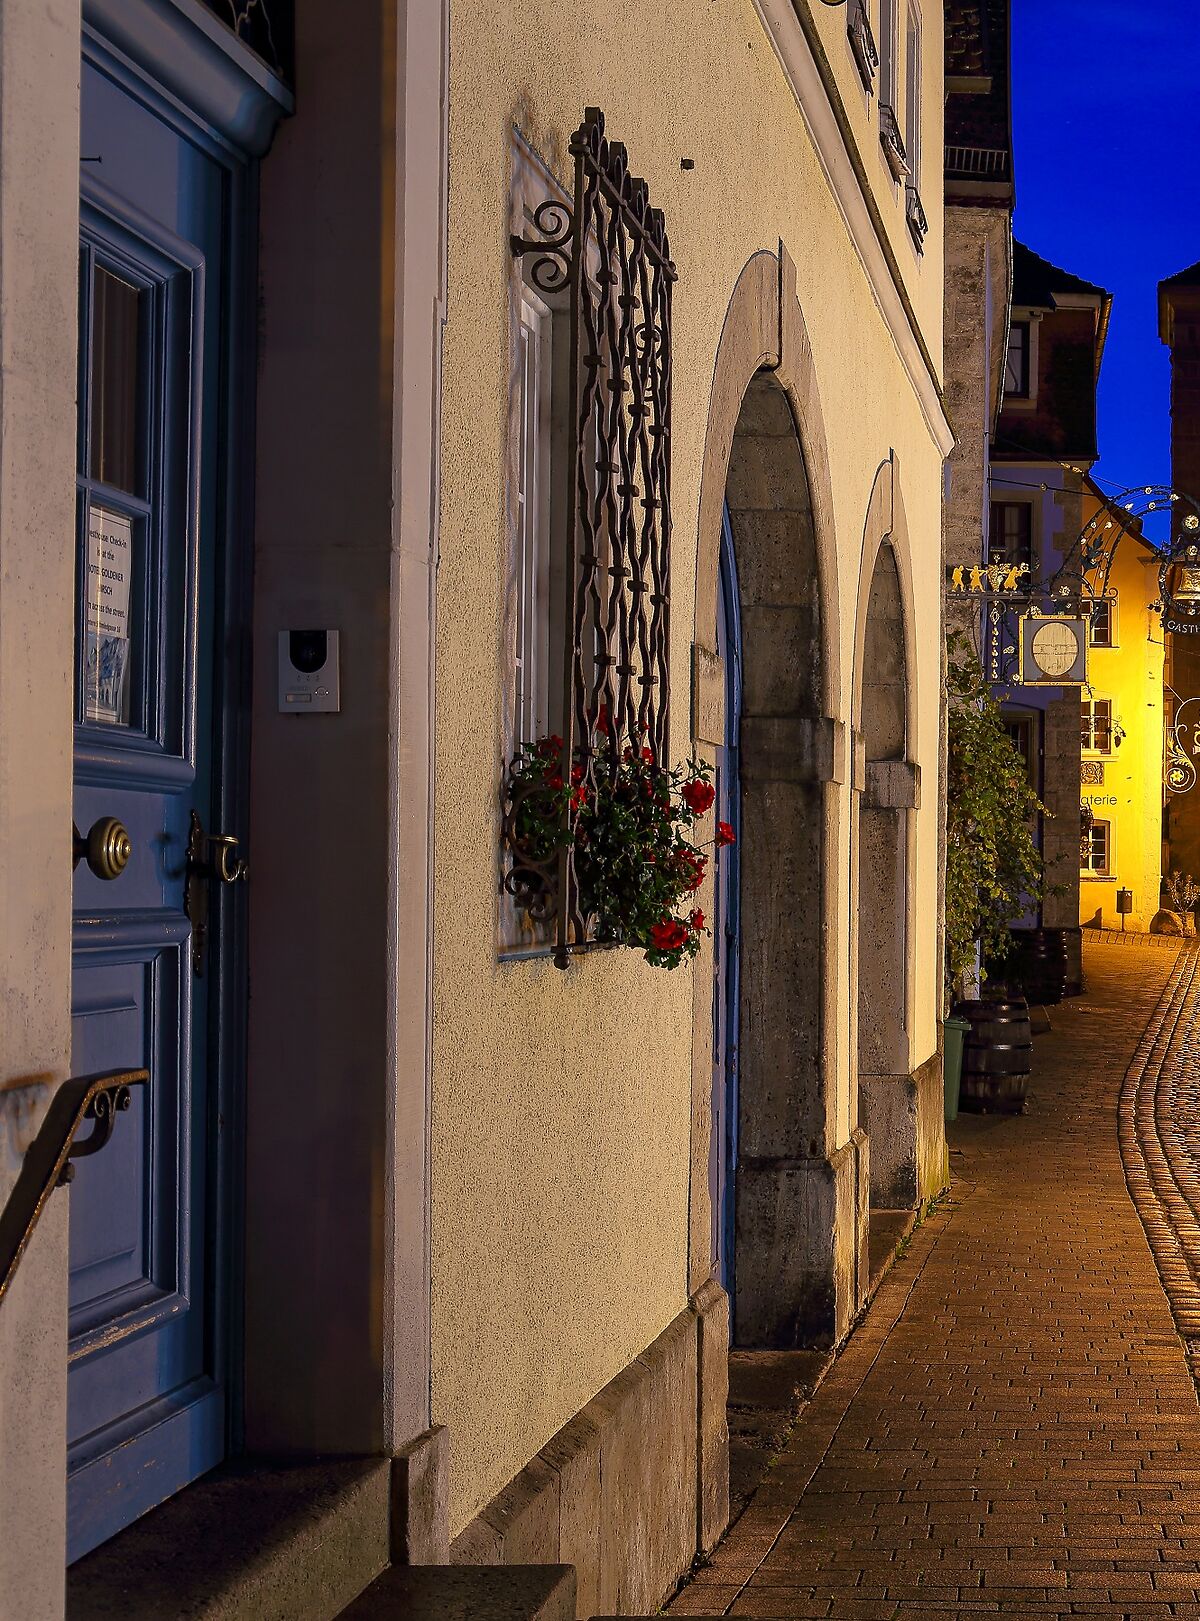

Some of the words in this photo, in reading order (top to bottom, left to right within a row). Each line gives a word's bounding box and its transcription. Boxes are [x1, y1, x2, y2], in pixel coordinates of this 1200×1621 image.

[109, 535, 127, 548] Check-in
[107, 550, 115, 560] the
[88, 564, 101, 576] HOTE
[101, 567, 124, 582] GOLDENER
[92, 603, 104, 613] acrss
